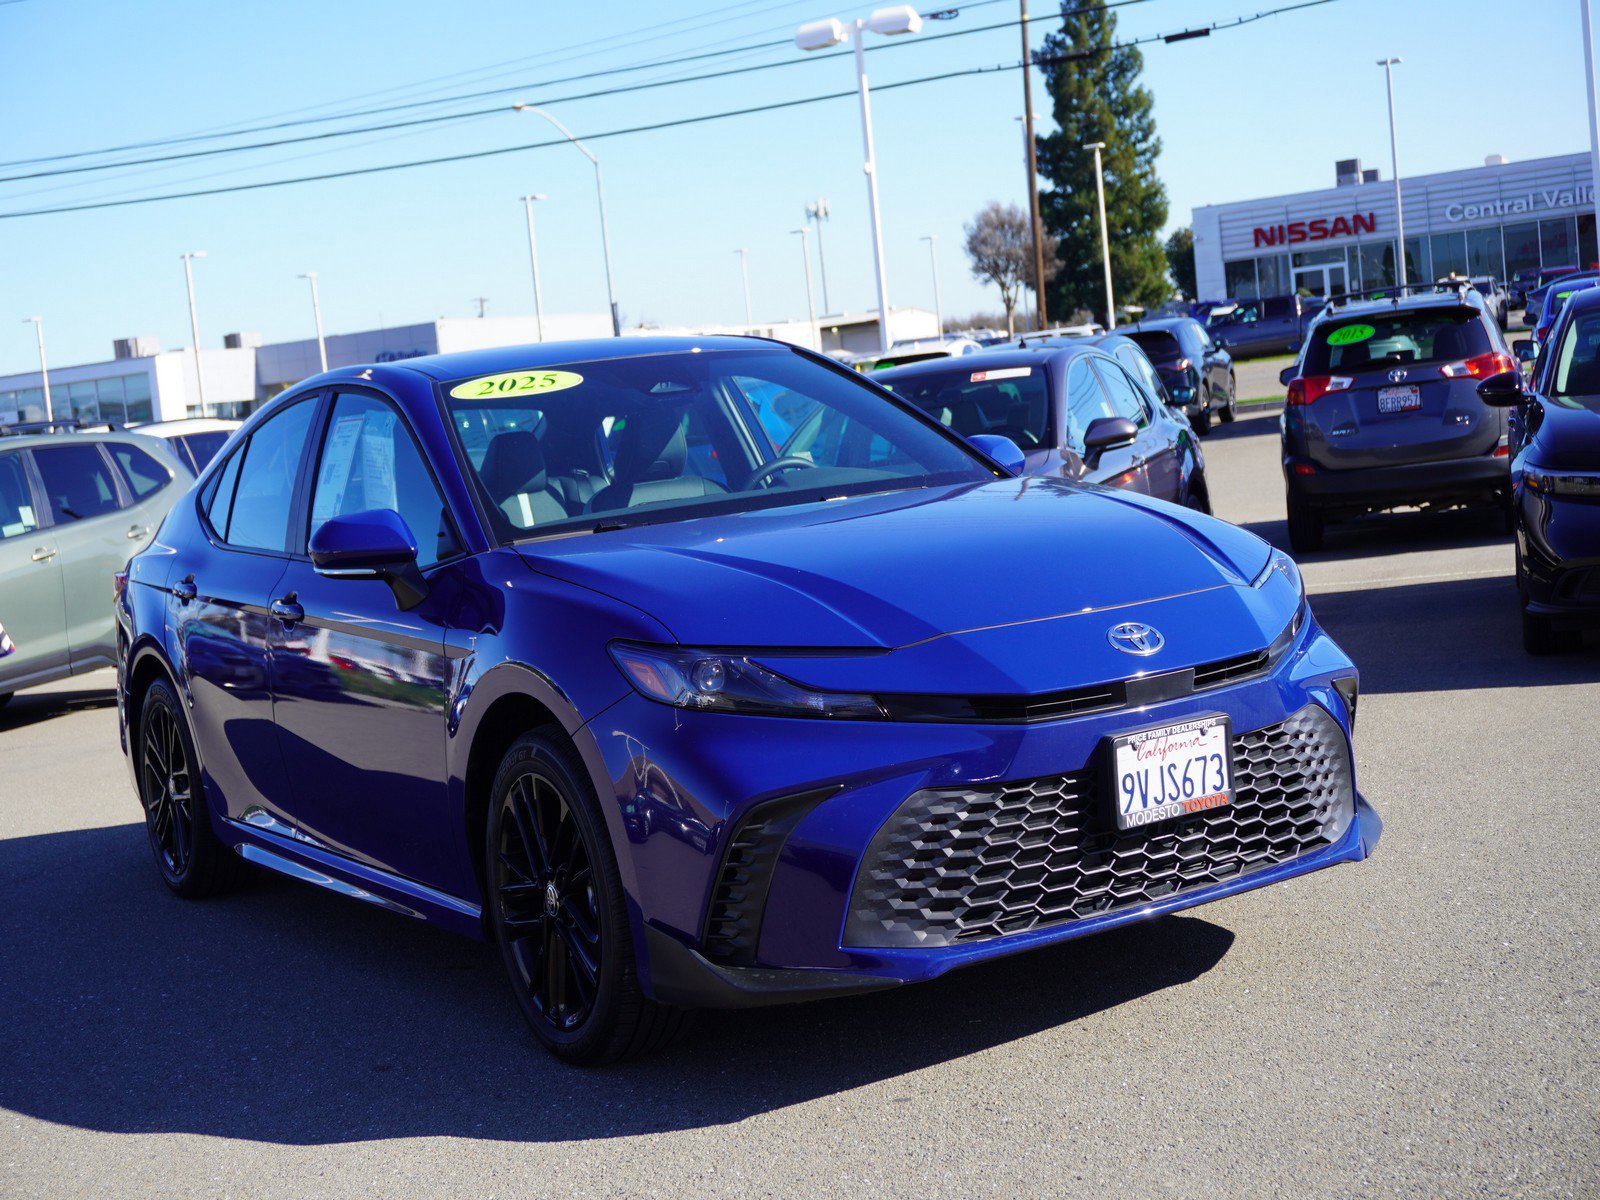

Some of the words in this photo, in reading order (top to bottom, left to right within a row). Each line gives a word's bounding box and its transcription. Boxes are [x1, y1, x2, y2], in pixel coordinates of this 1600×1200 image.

[1445, 193, 1534, 222] Central
[1253, 212, 1375, 248] NISSAN
[1334, 325, 1367, 343] 2015
[477, 373, 558, 396] 2025
[1127, 734, 1147, 744] PRICE
[1147, 728, 1171, 740] FAMILY
[1172, 719, 1217, 736] DEALERSHIPS
[1136, 736, 1208, 762] California
[1122, 753, 1225, 814] 9VJS673
[1126, 803, 1180, 828] MODESTO
[1183, 793, 1229, 814] TOYOTA
